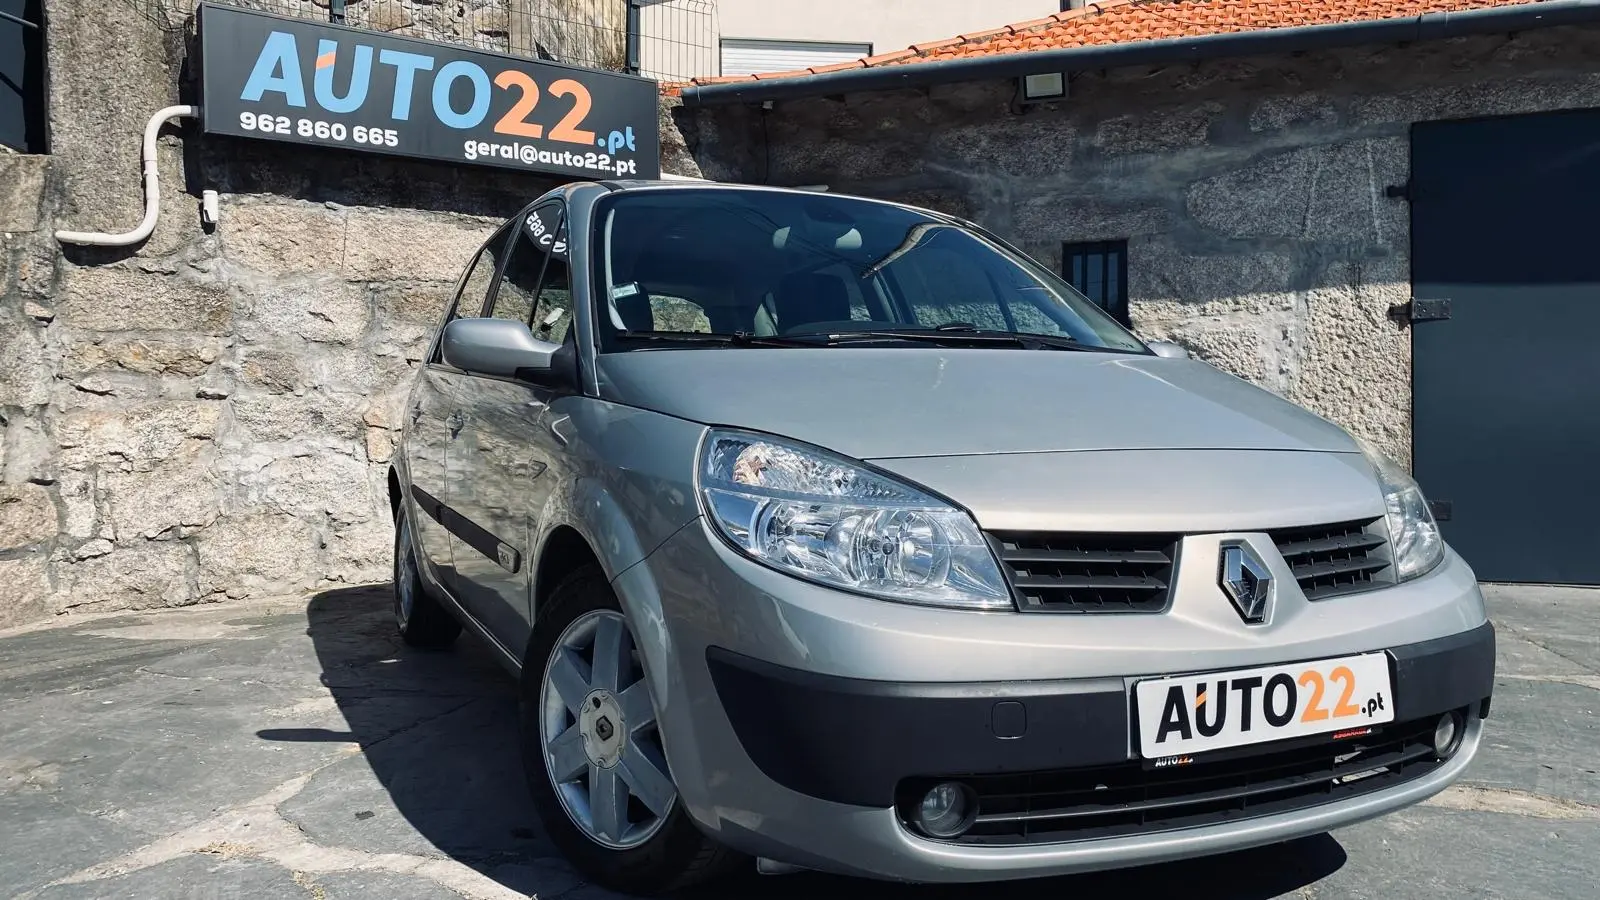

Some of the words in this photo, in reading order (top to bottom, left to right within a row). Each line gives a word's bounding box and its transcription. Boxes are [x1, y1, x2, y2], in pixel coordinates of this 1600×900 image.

[240, 30, 636, 155] AUTO22.pt
[239, 111, 291, 135] 962
[297, 118, 347, 141] 860
[352, 125, 399, 147] 665
[464, 139, 637, 177] geral@auto22.pt
[1155, 665, 1385, 743] AUTO22.pt
